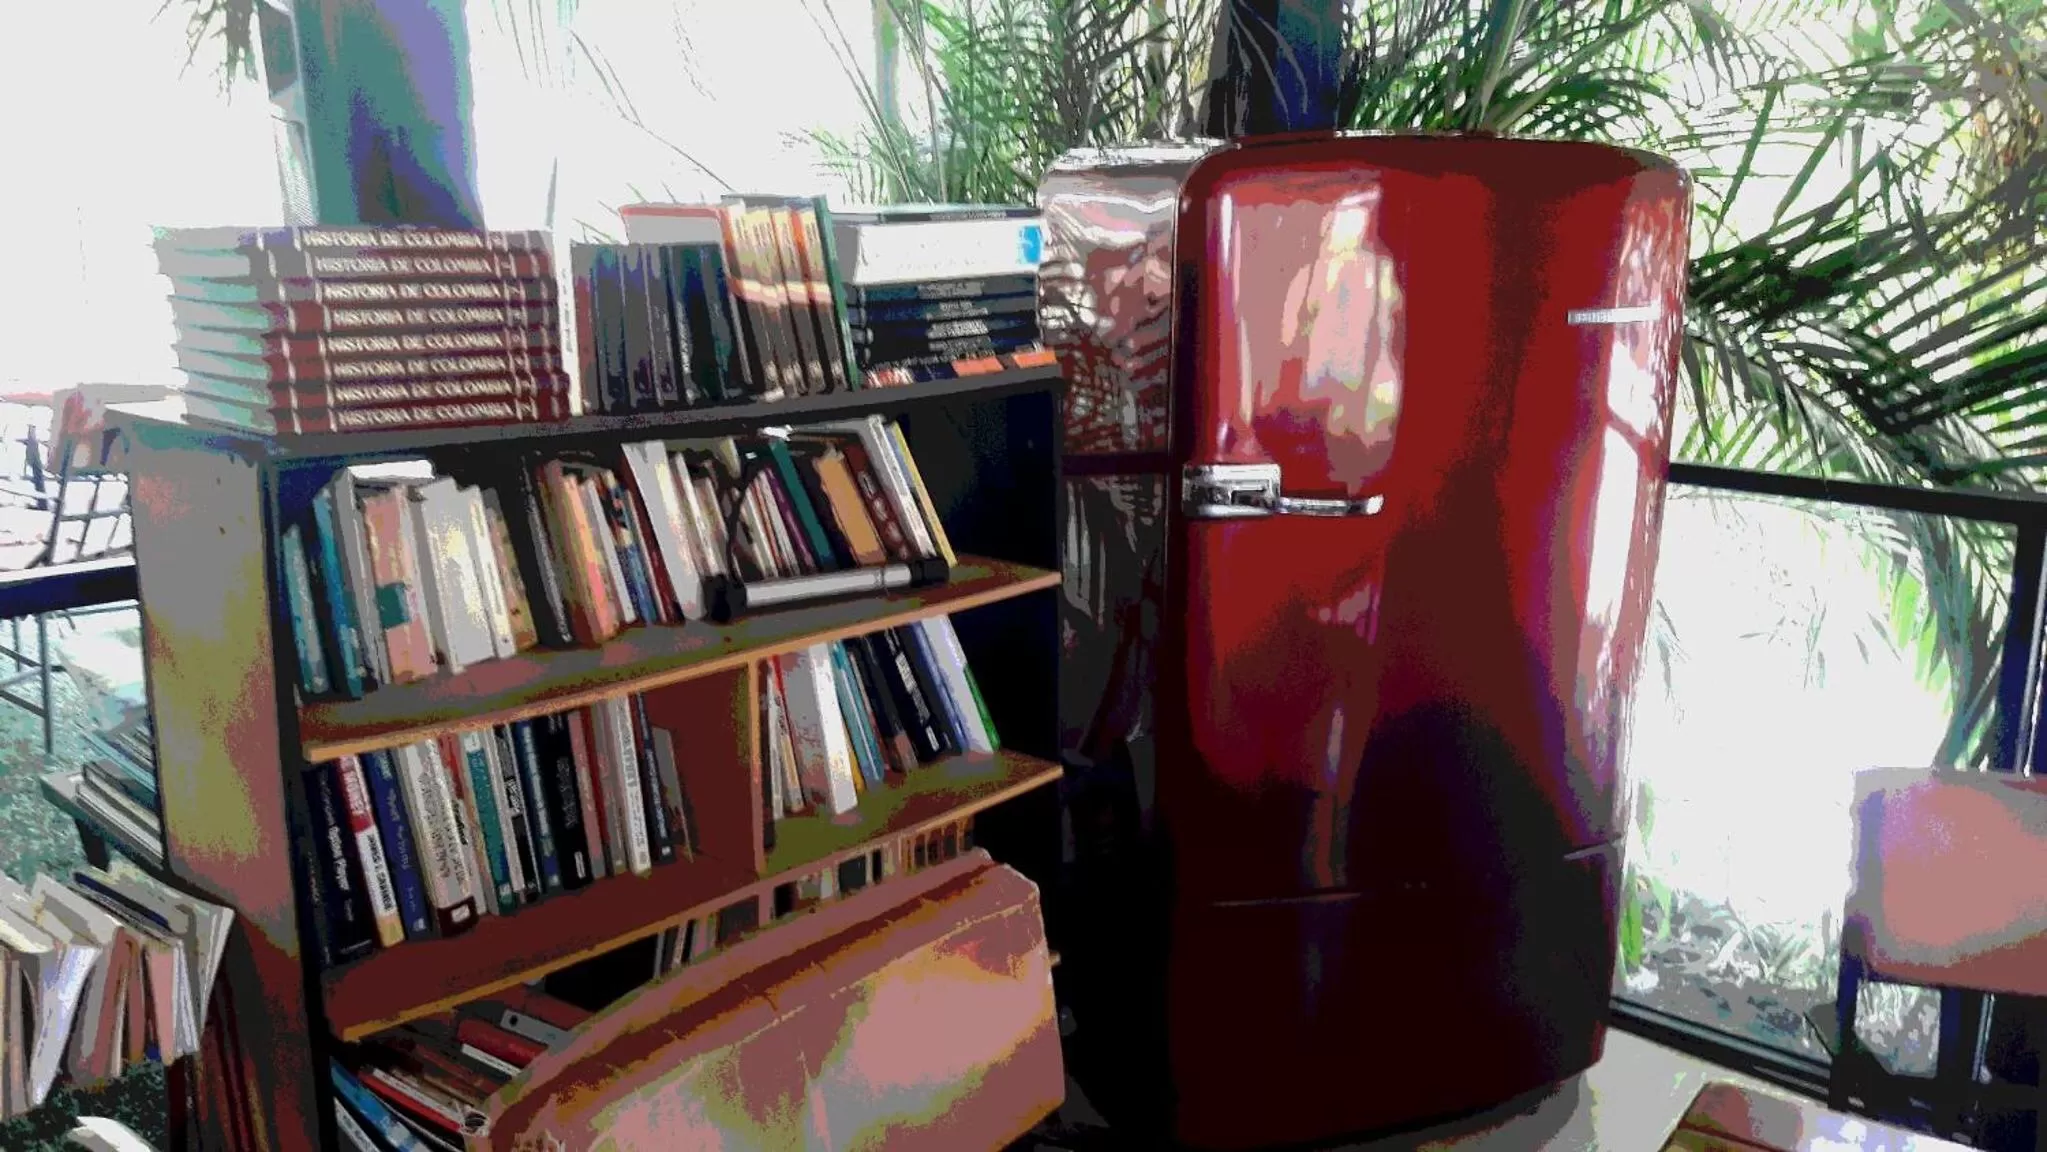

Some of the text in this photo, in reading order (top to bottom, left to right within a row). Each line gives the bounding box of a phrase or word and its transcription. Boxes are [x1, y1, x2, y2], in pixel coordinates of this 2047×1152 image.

[302, 230, 379, 247] HISTORIA
[380, 231, 401, 247] DE
[403, 230, 484, 248] COLOMBIA
[315, 256, 388, 272] HISTORIA
[390, 256, 411, 273] DE
[413, 256, 493, 273] COLOMBIA
[324, 282, 398, 299] HISTORIA
[399, 282, 420, 299] DE
[422, 282, 502, 299] COLOMBIA
[332, 308, 405, 326] HISTORIA
[406, 308, 427, 325] DE
[428, 307, 505, 324] COLOMBIA
[328, 335, 401, 352] HISTORIA
[402, 335, 424, 351] DE
[425, 332, 503, 349] COLOMBIA
[334, 360, 407, 377] HISTORIA
[408, 359, 429, 375] DE
[430, 355, 507, 374] COLOMBIA
[335, 386, 410, 402] HISTORIA
[411, 383, 433, 400] DE
[434, 380, 513, 397] COLOMBIA
[338, 409, 411, 426] HISTORIA
[412, 406, 435, 423] DE
[436, 402, 515, 420] COLOMBIA
